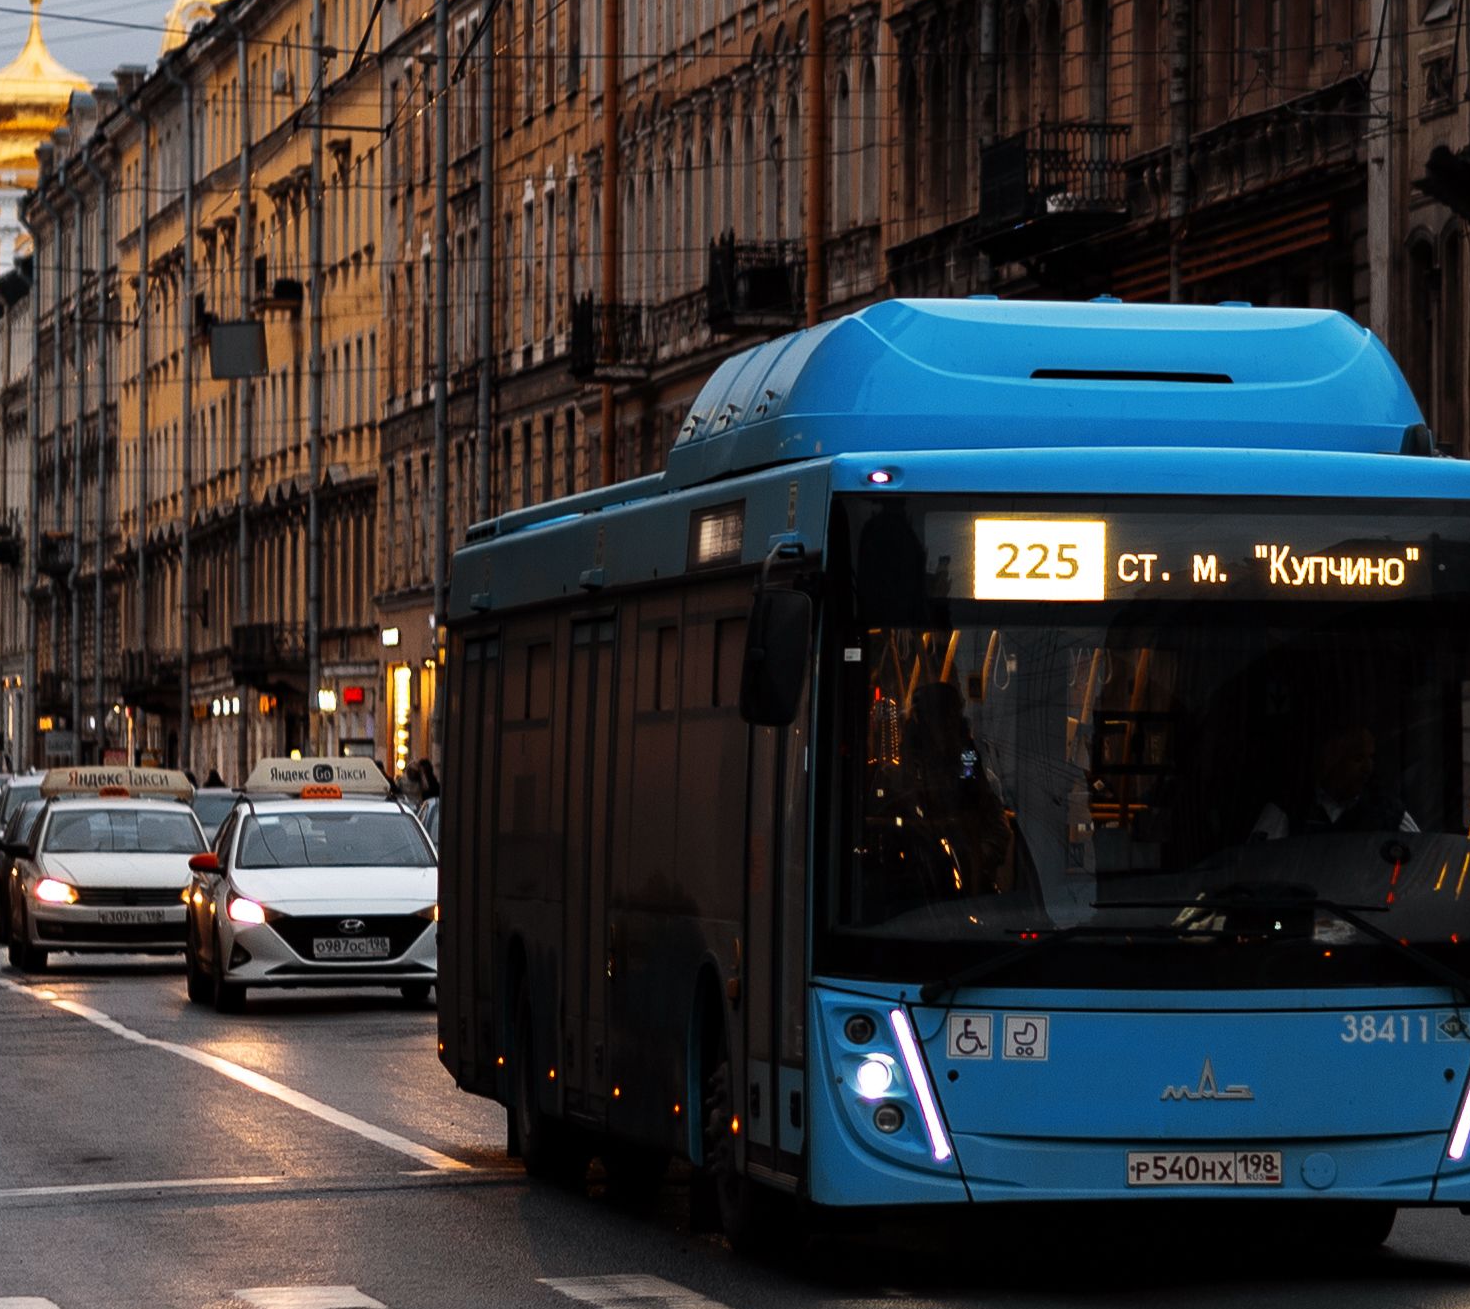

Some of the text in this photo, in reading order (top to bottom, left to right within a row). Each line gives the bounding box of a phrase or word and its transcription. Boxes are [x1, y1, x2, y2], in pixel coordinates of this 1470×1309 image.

[995, 543, 1080, 580] 225
[1254, 545, 1420, 586] "Купчино"
[68, 769, 170, 788] Яндекс Такси
[270, 766, 368, 782] Яндекс Go Такси
[1341, 1014, 1429, 1043] 38411
[1135, 1153, 1276, 1182] Р540НХ 198
